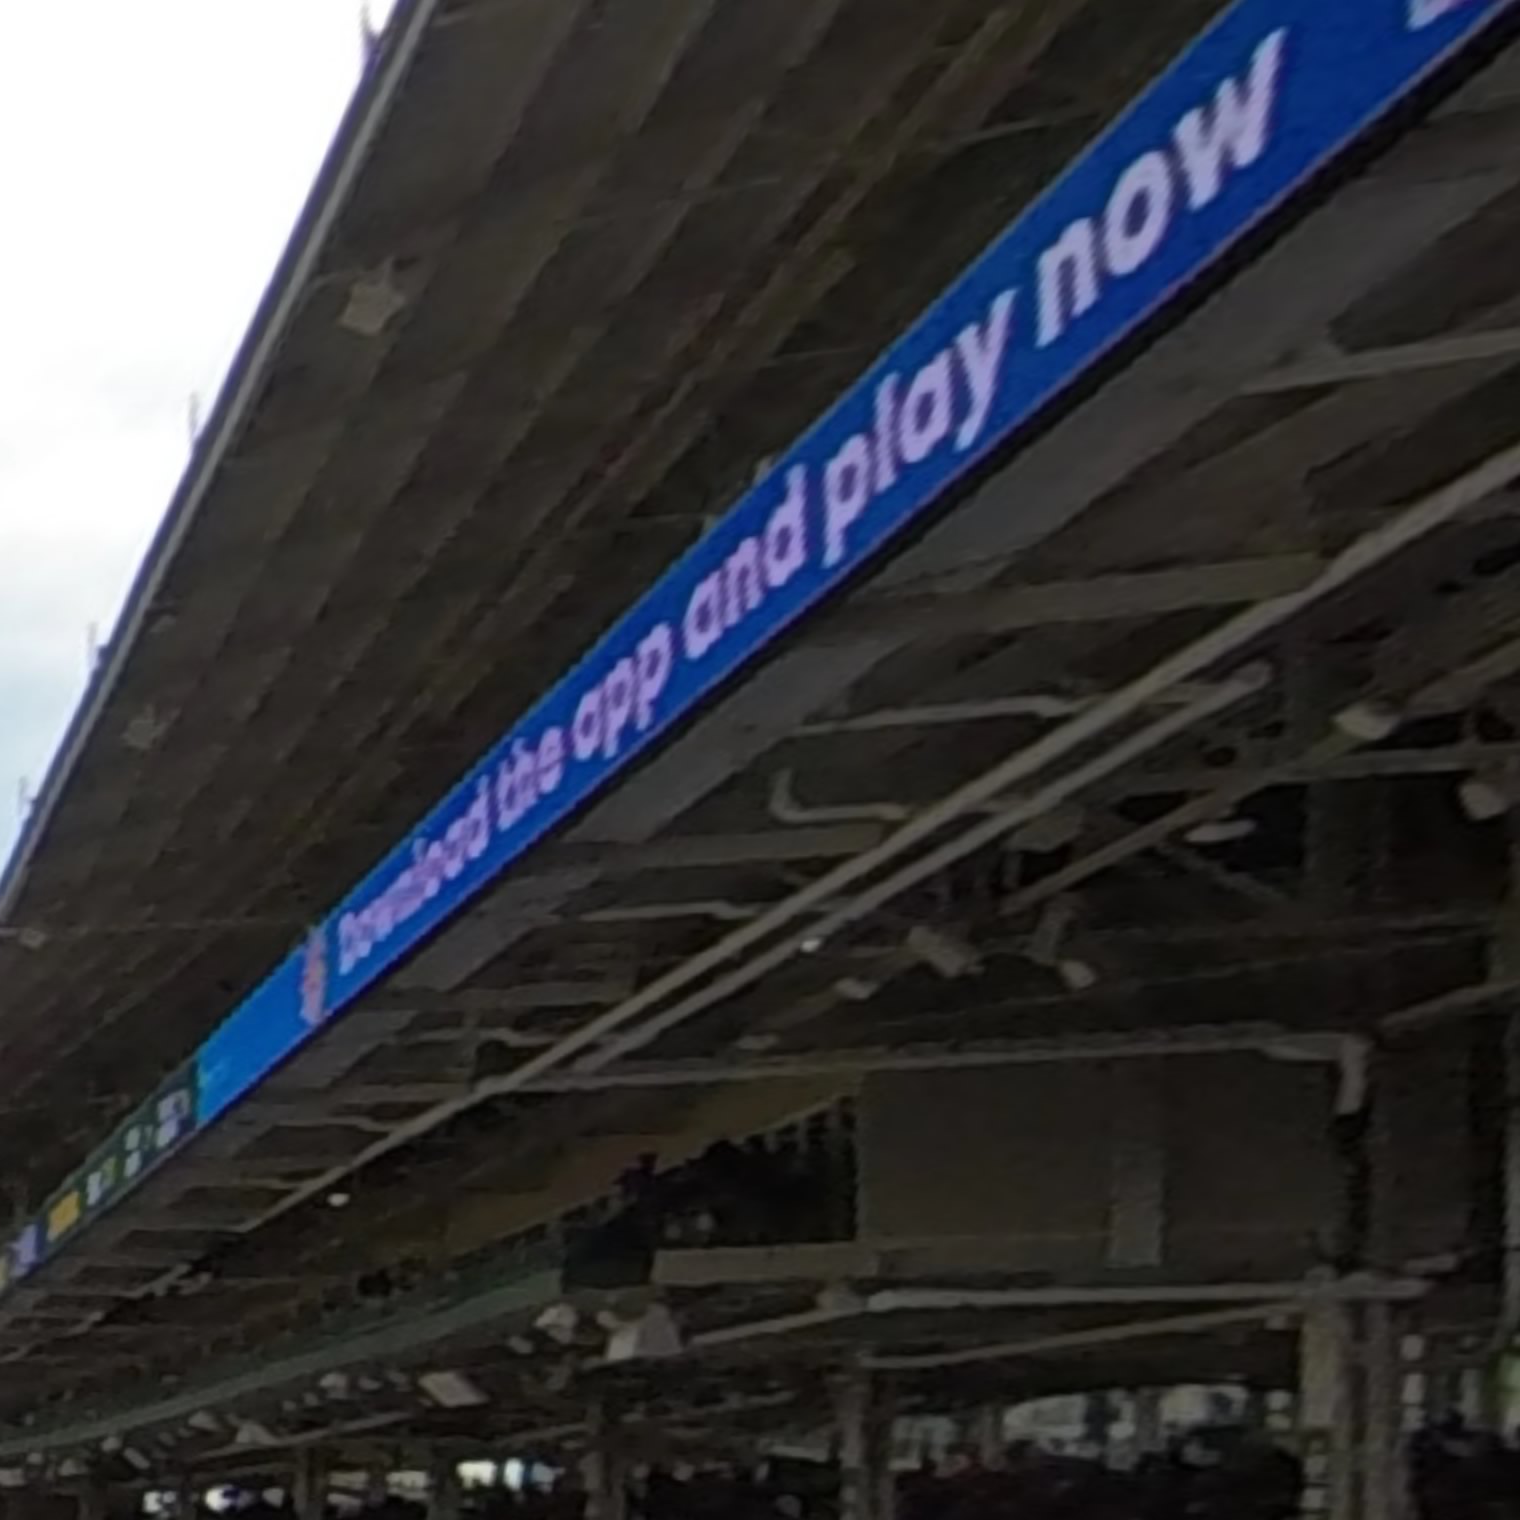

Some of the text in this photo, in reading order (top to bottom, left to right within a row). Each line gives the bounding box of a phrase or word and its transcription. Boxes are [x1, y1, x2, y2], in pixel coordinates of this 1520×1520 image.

[338, 26, 1289, 975] Download the app and play now
